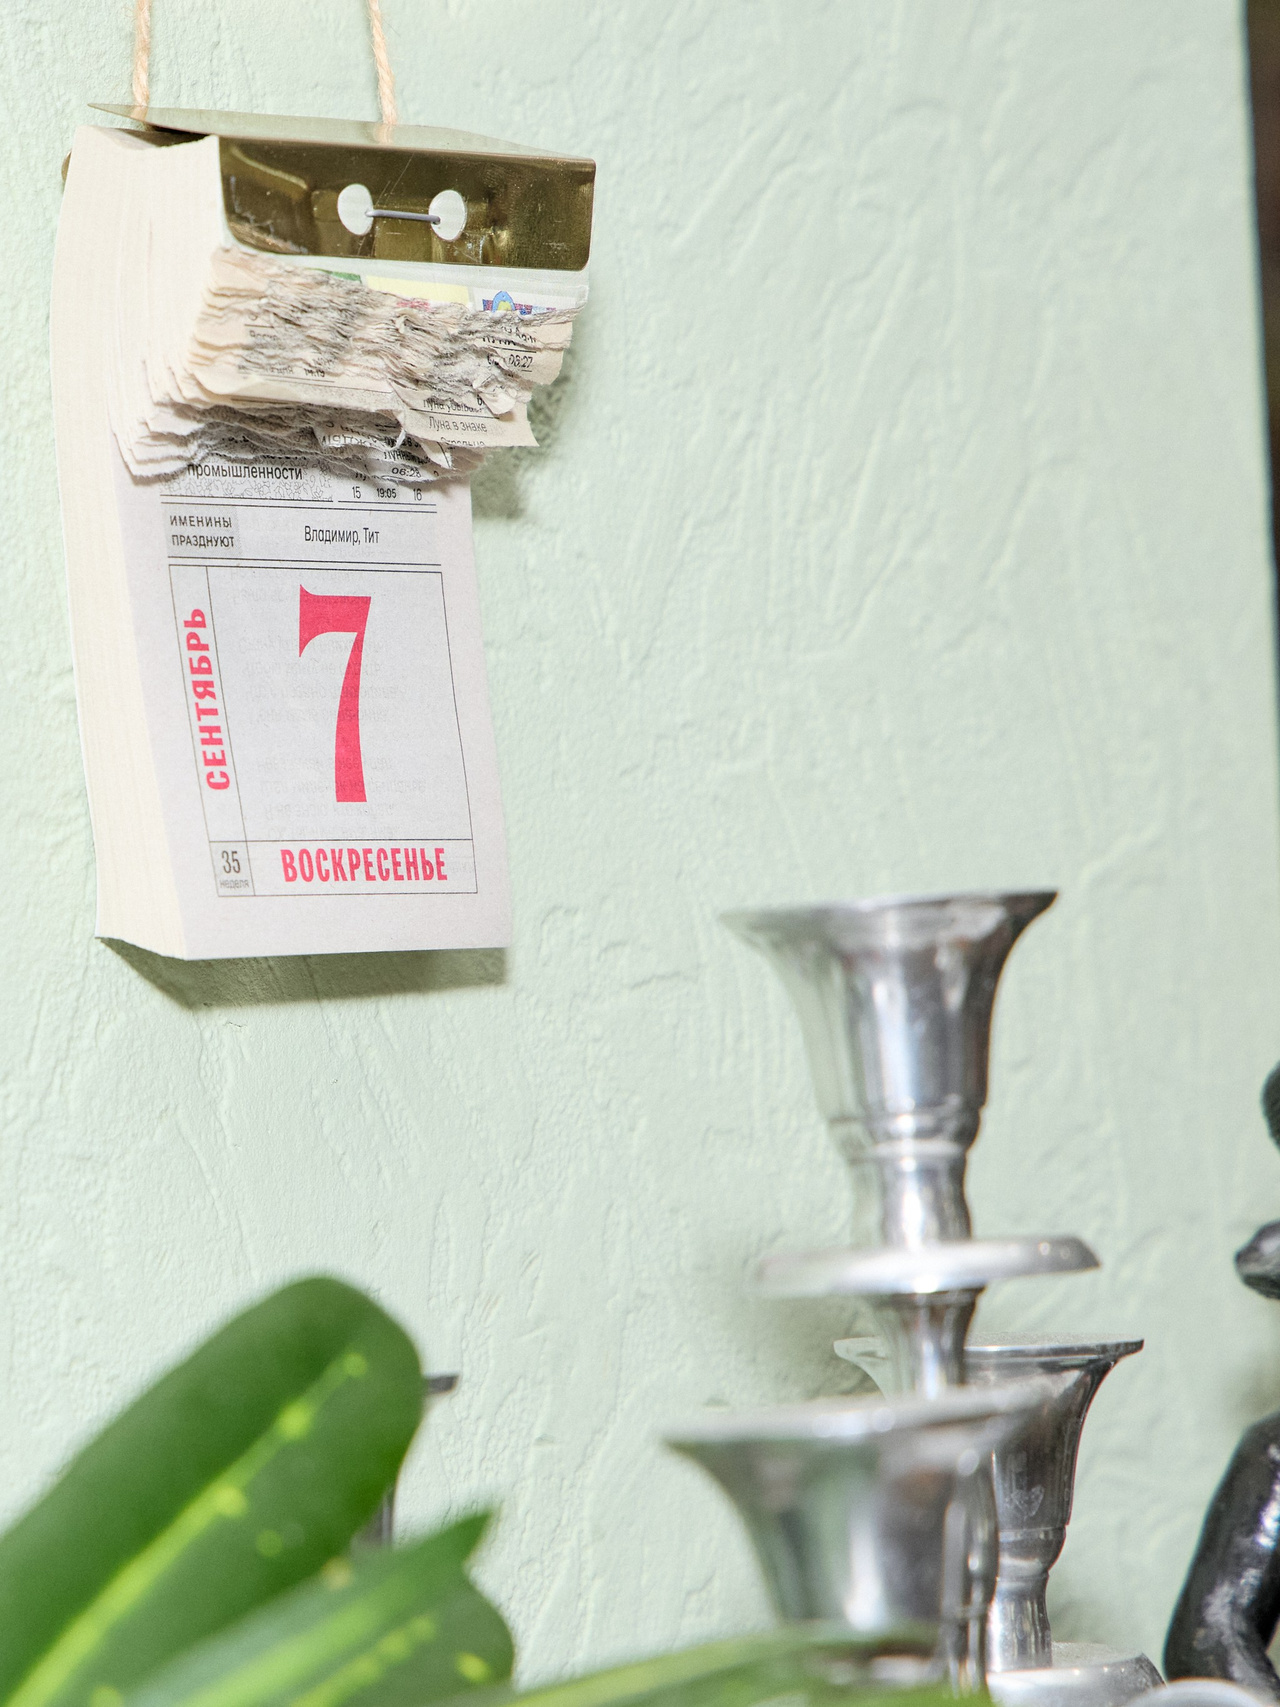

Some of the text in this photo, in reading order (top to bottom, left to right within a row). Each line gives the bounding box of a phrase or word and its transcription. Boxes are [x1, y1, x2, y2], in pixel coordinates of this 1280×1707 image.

[429, 416, 488, 432] Луна в знаке
[187, 463, 304, 481] промышленности
[351, 486, 423, 501] 15 19:05 16
[170, 515, 233, 528] ИМЕНИНЫ
[171, 534, 235, 548] ПРАЗДНУЮТ
[304, 525, 380, 546] Владимир, Тит
[183, 607, 231, 791] СЕНТЯБРЬ
[299, 584, 372, 803] 7
[221, 850, 241, 874] 35
[280, 847, 449, 882] ВОСКРЕСЕНЬЕ
